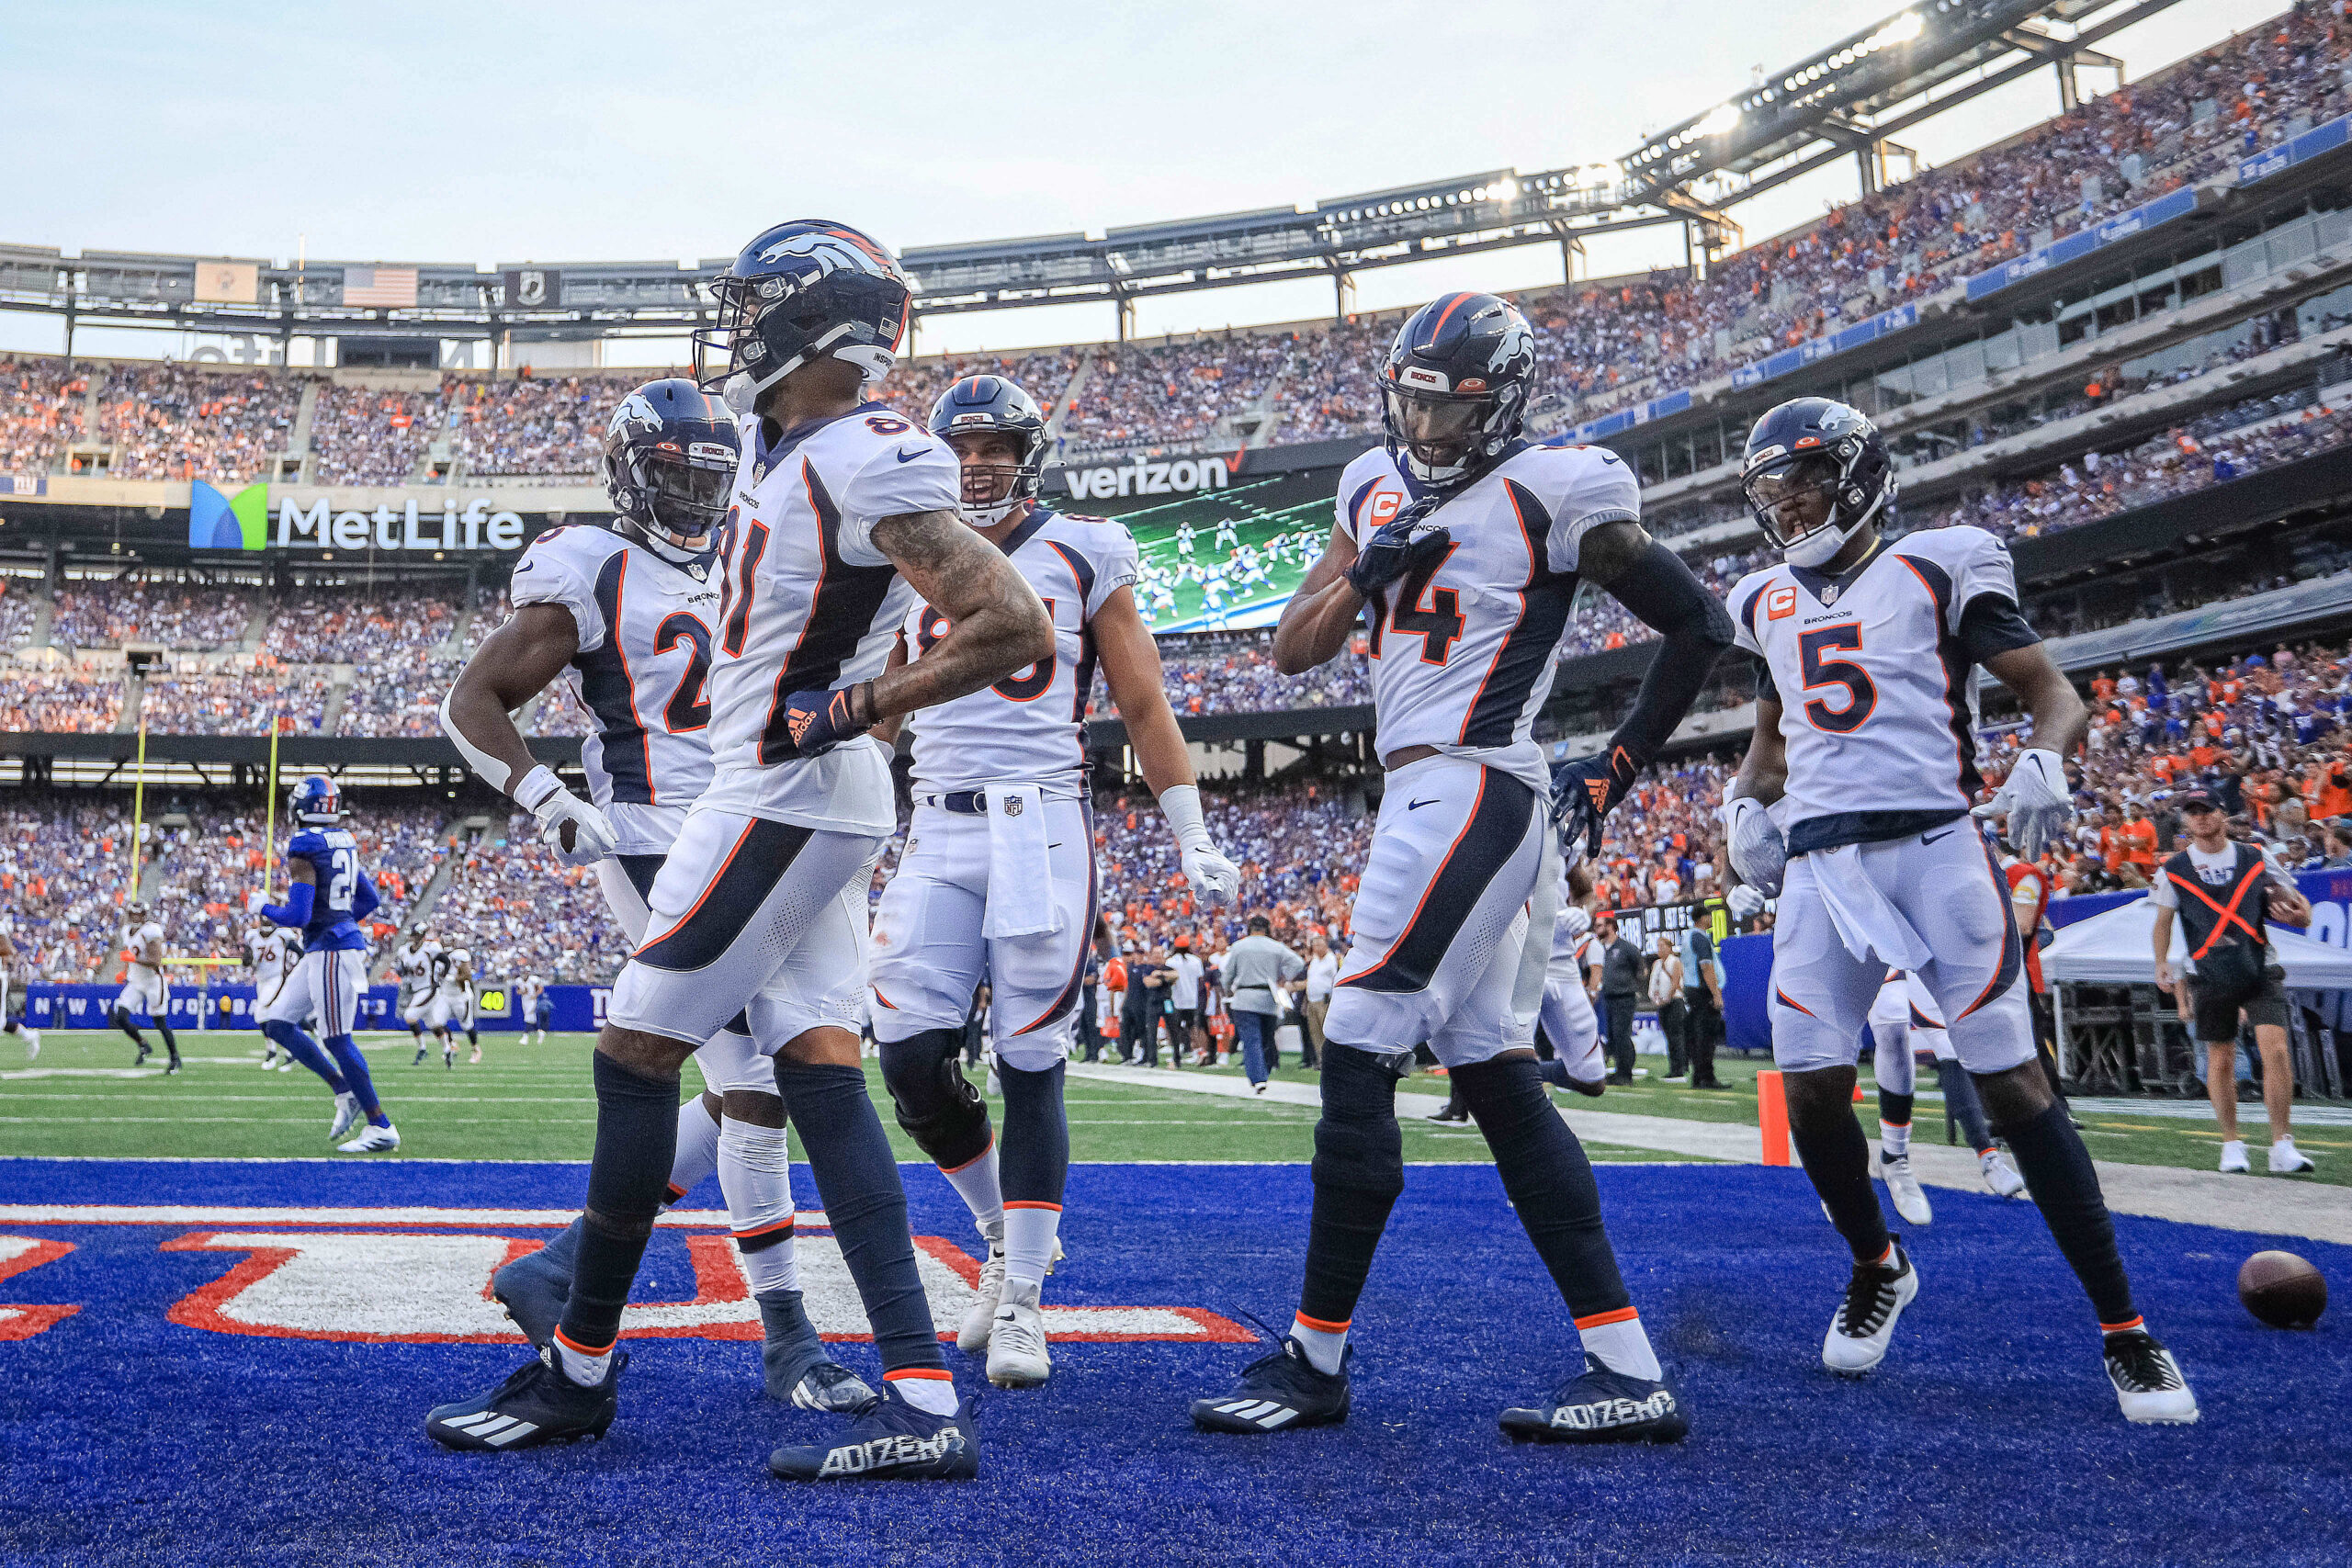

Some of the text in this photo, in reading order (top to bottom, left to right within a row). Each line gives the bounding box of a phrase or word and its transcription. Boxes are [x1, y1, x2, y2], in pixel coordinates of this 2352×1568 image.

[701, 446, 725, 457] BRONCOS
[1064, 455, 1228, 501] verizon
[739, 491, 761, 509] BRONCOS
[277, 497, 525, 550] MetLife
[687, 592, 720, 604] BRONC
[1769, 588, 1795, 612] C
[1804, 610, 1853, 625] BRONCOS
[1798, 621, 1878, 733] 5
[34, 998, 88, 1016] NW
[479, 991, 505, 1011] 40
[1551, 1390, 1676, 1429] ADIZERO
[814, 1426, 963, 1477] ADIZERO
